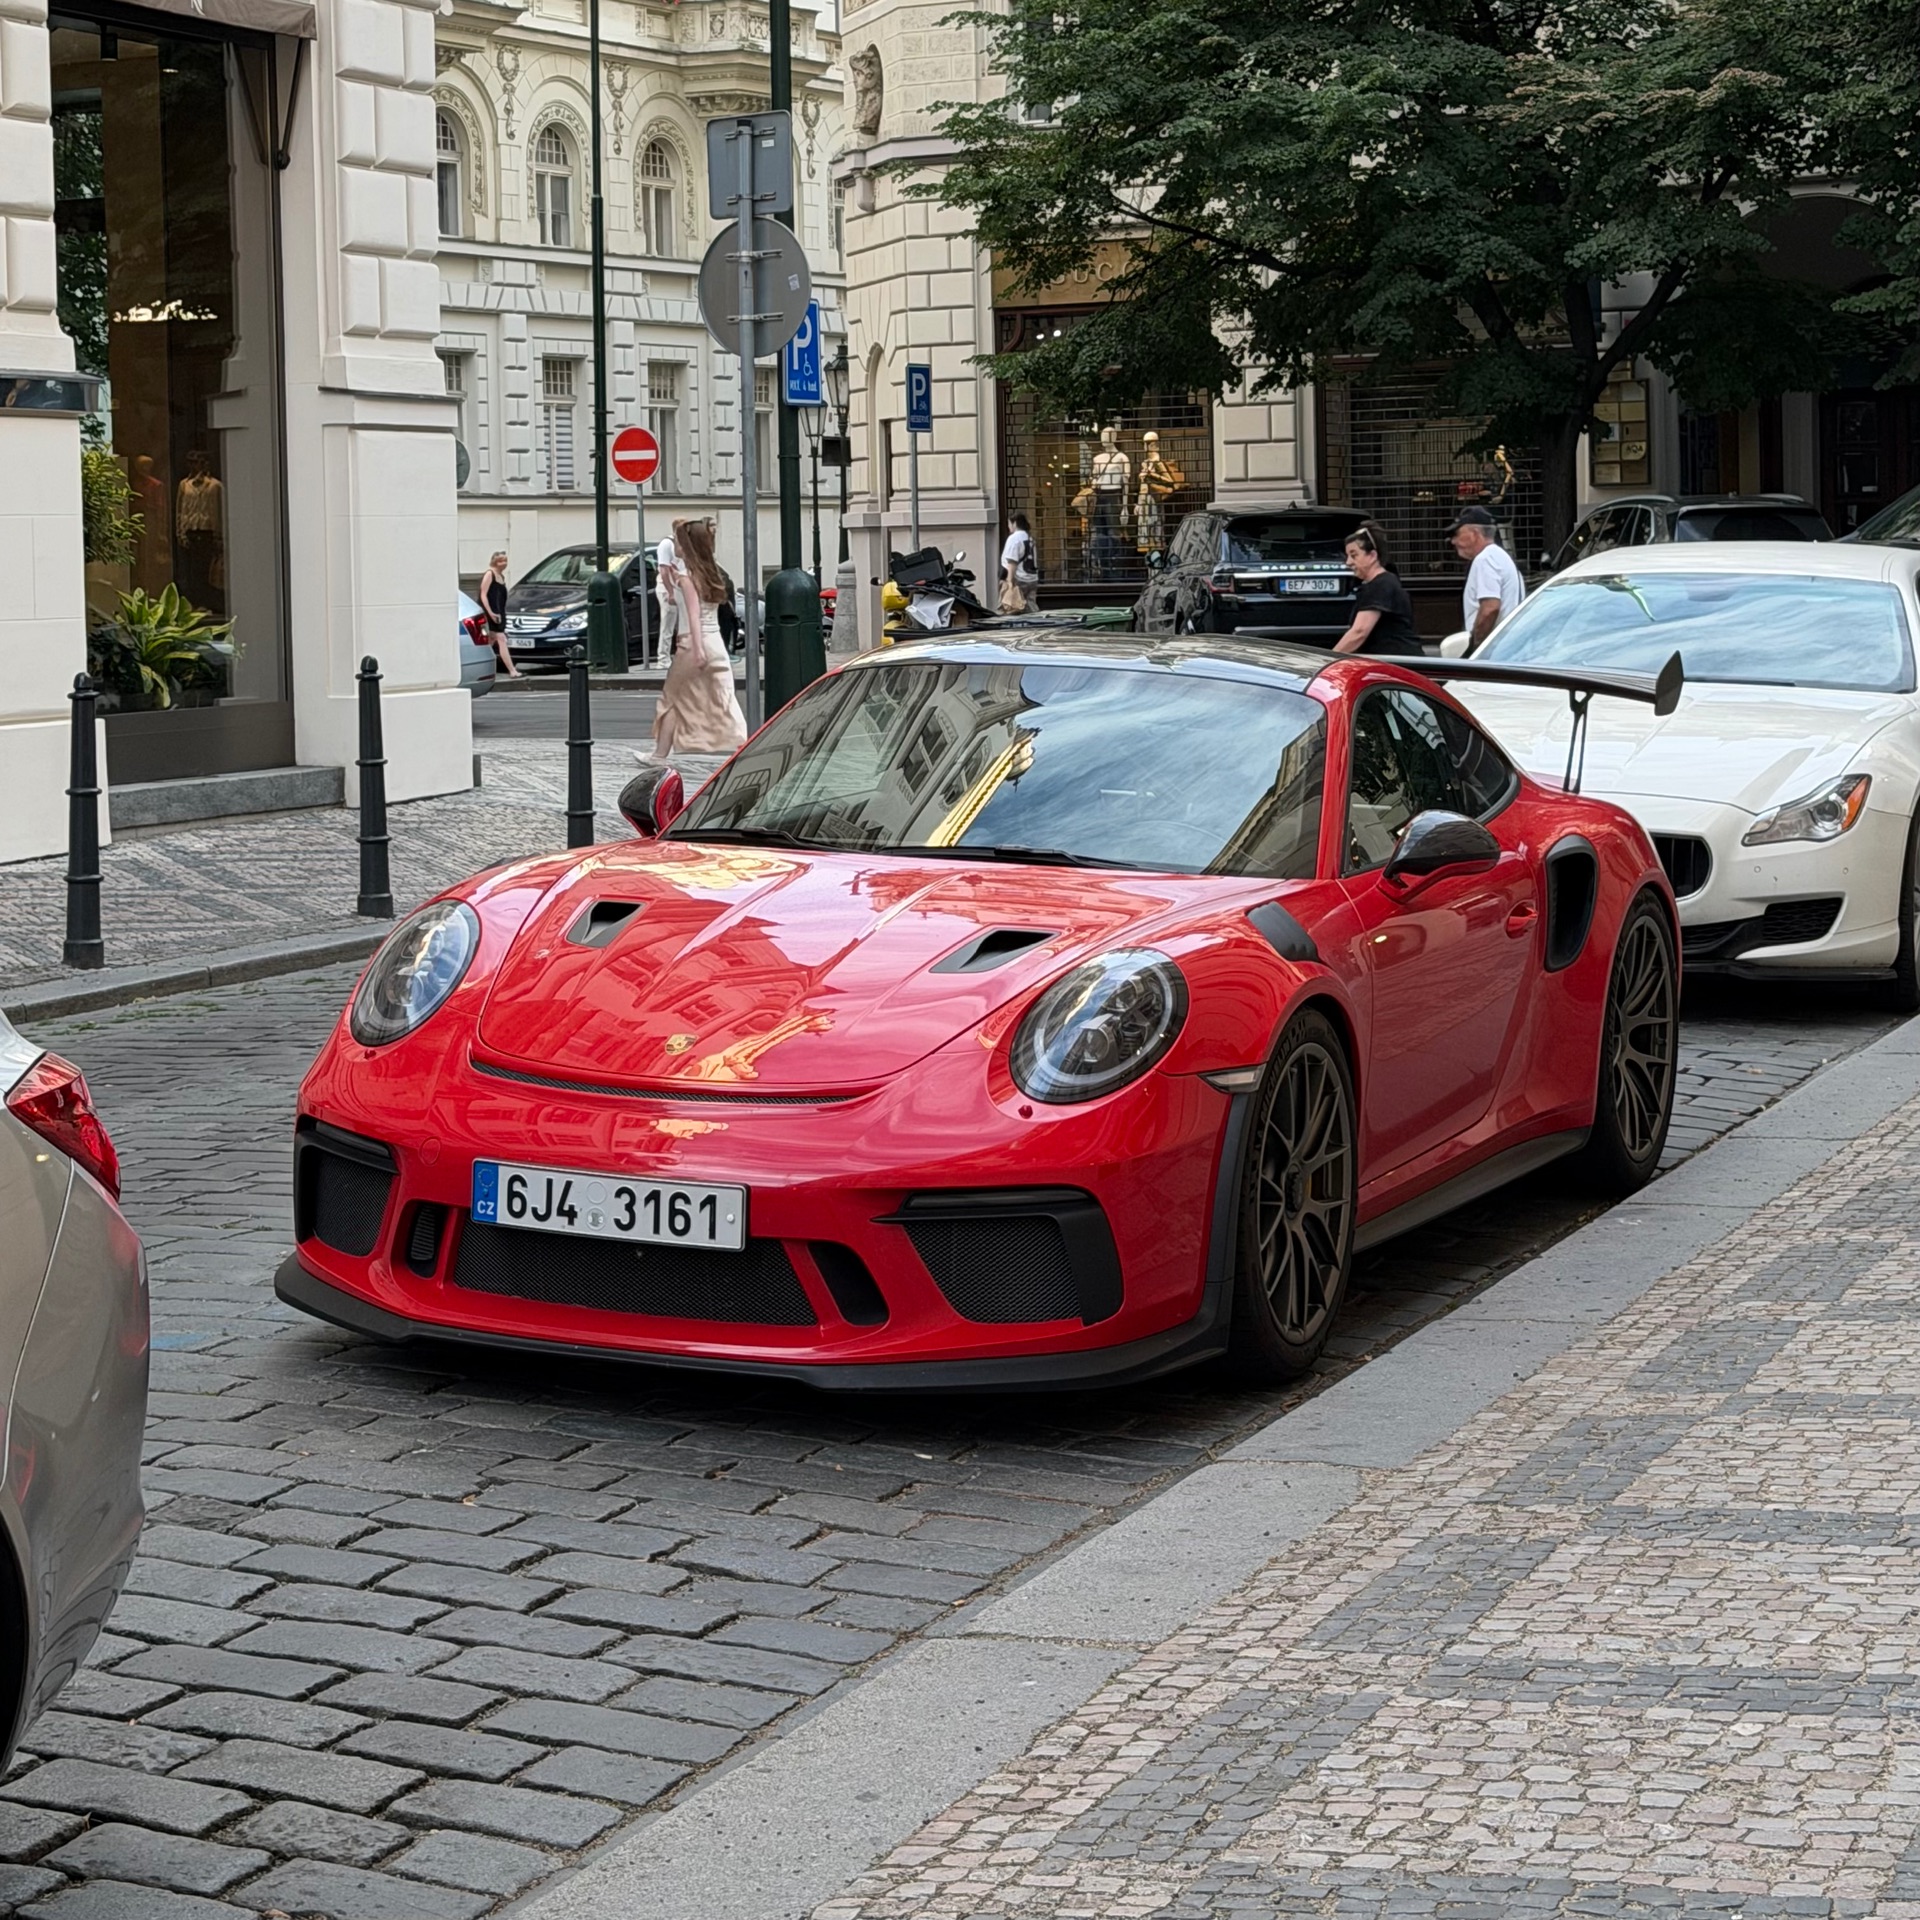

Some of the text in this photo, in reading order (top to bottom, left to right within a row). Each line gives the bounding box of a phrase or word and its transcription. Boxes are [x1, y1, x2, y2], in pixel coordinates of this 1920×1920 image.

[793, 315, 812, 371] P
[912, 373, 927, 410] P
[1288, 580, 1335, 590] 6E7 3075
[477, 1199, 495, 1216] CZ
[506, 1174, 718, 1240] 6J4 3161
